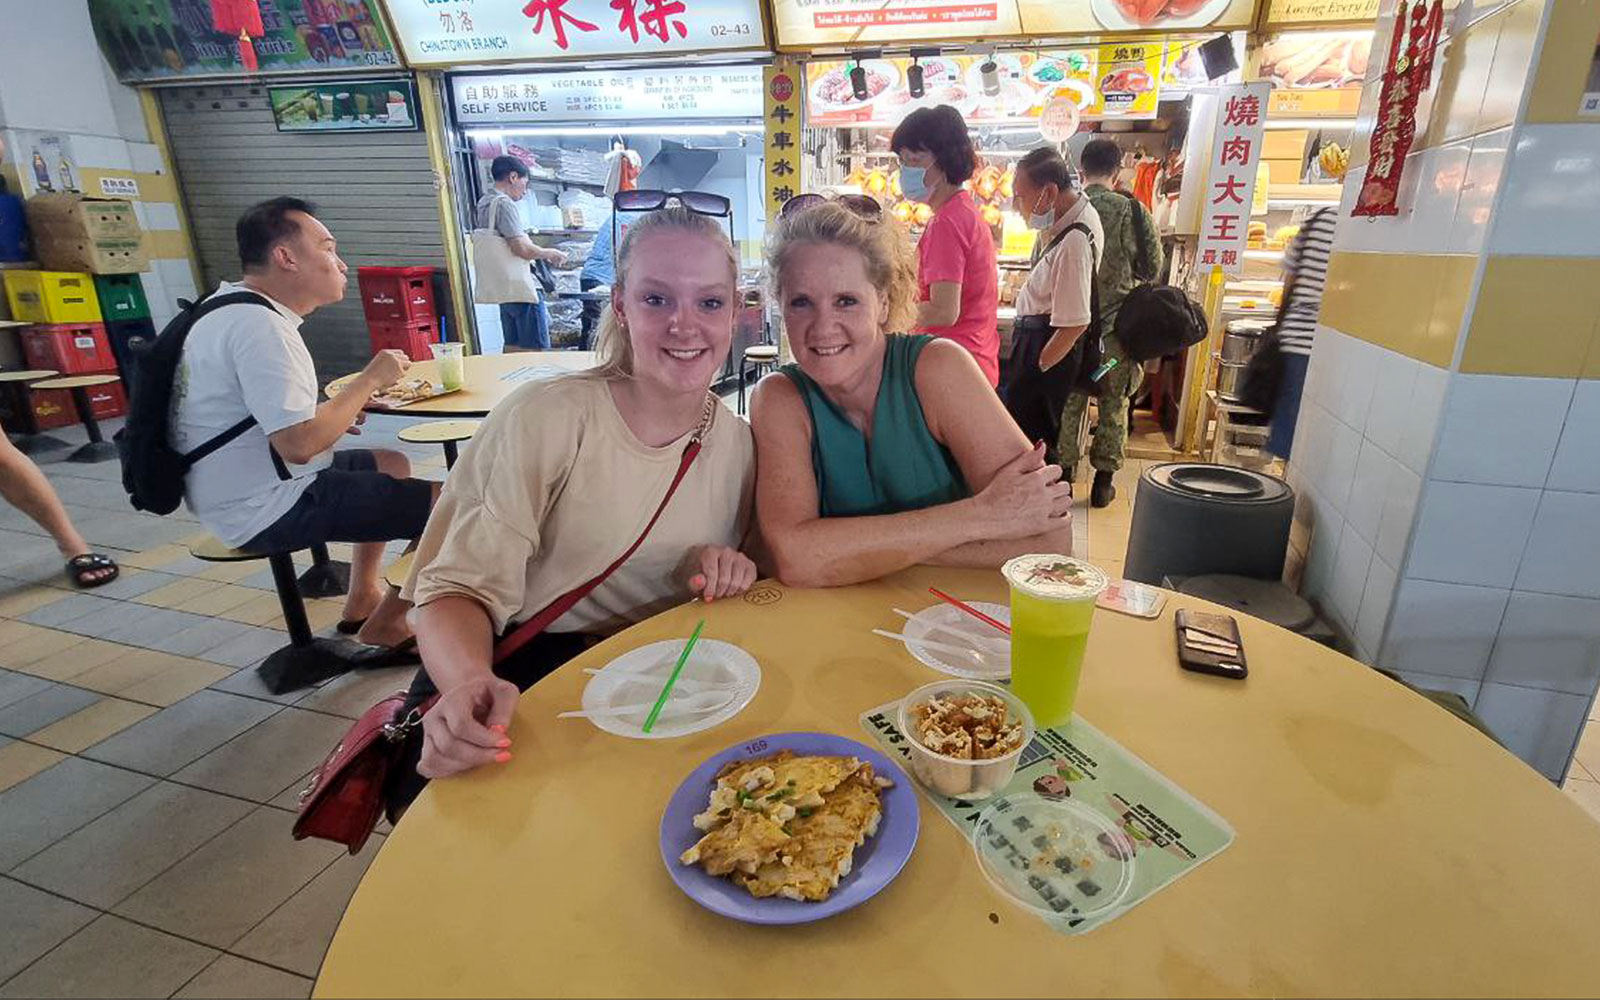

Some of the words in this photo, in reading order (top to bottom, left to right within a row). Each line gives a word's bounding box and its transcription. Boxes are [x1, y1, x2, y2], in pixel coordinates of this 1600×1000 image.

[1285, 5, 1325, 17] Loving
[1327, 2, 1362, 15] Every
[711, 24, 750, 36] 02-43
[420, 39, 471, 53] CHINATOWN
[472, 36, 508, 50] BRANCH
[365, 51, 396, 65] 02-42
[551, 79, 604, 88] VEGETABLE
[462, 103, 490, 114] SELF
[497, 101, 547, 113] SERVICE
[1207, 94, 1260, 241] 燒肉大王
[868, 713, 905, 743] SAFE
[746, 740, 768, 754] 169
[1146, 818, 1164, 833] after
[1175, 840, 1197, 859] Clean
